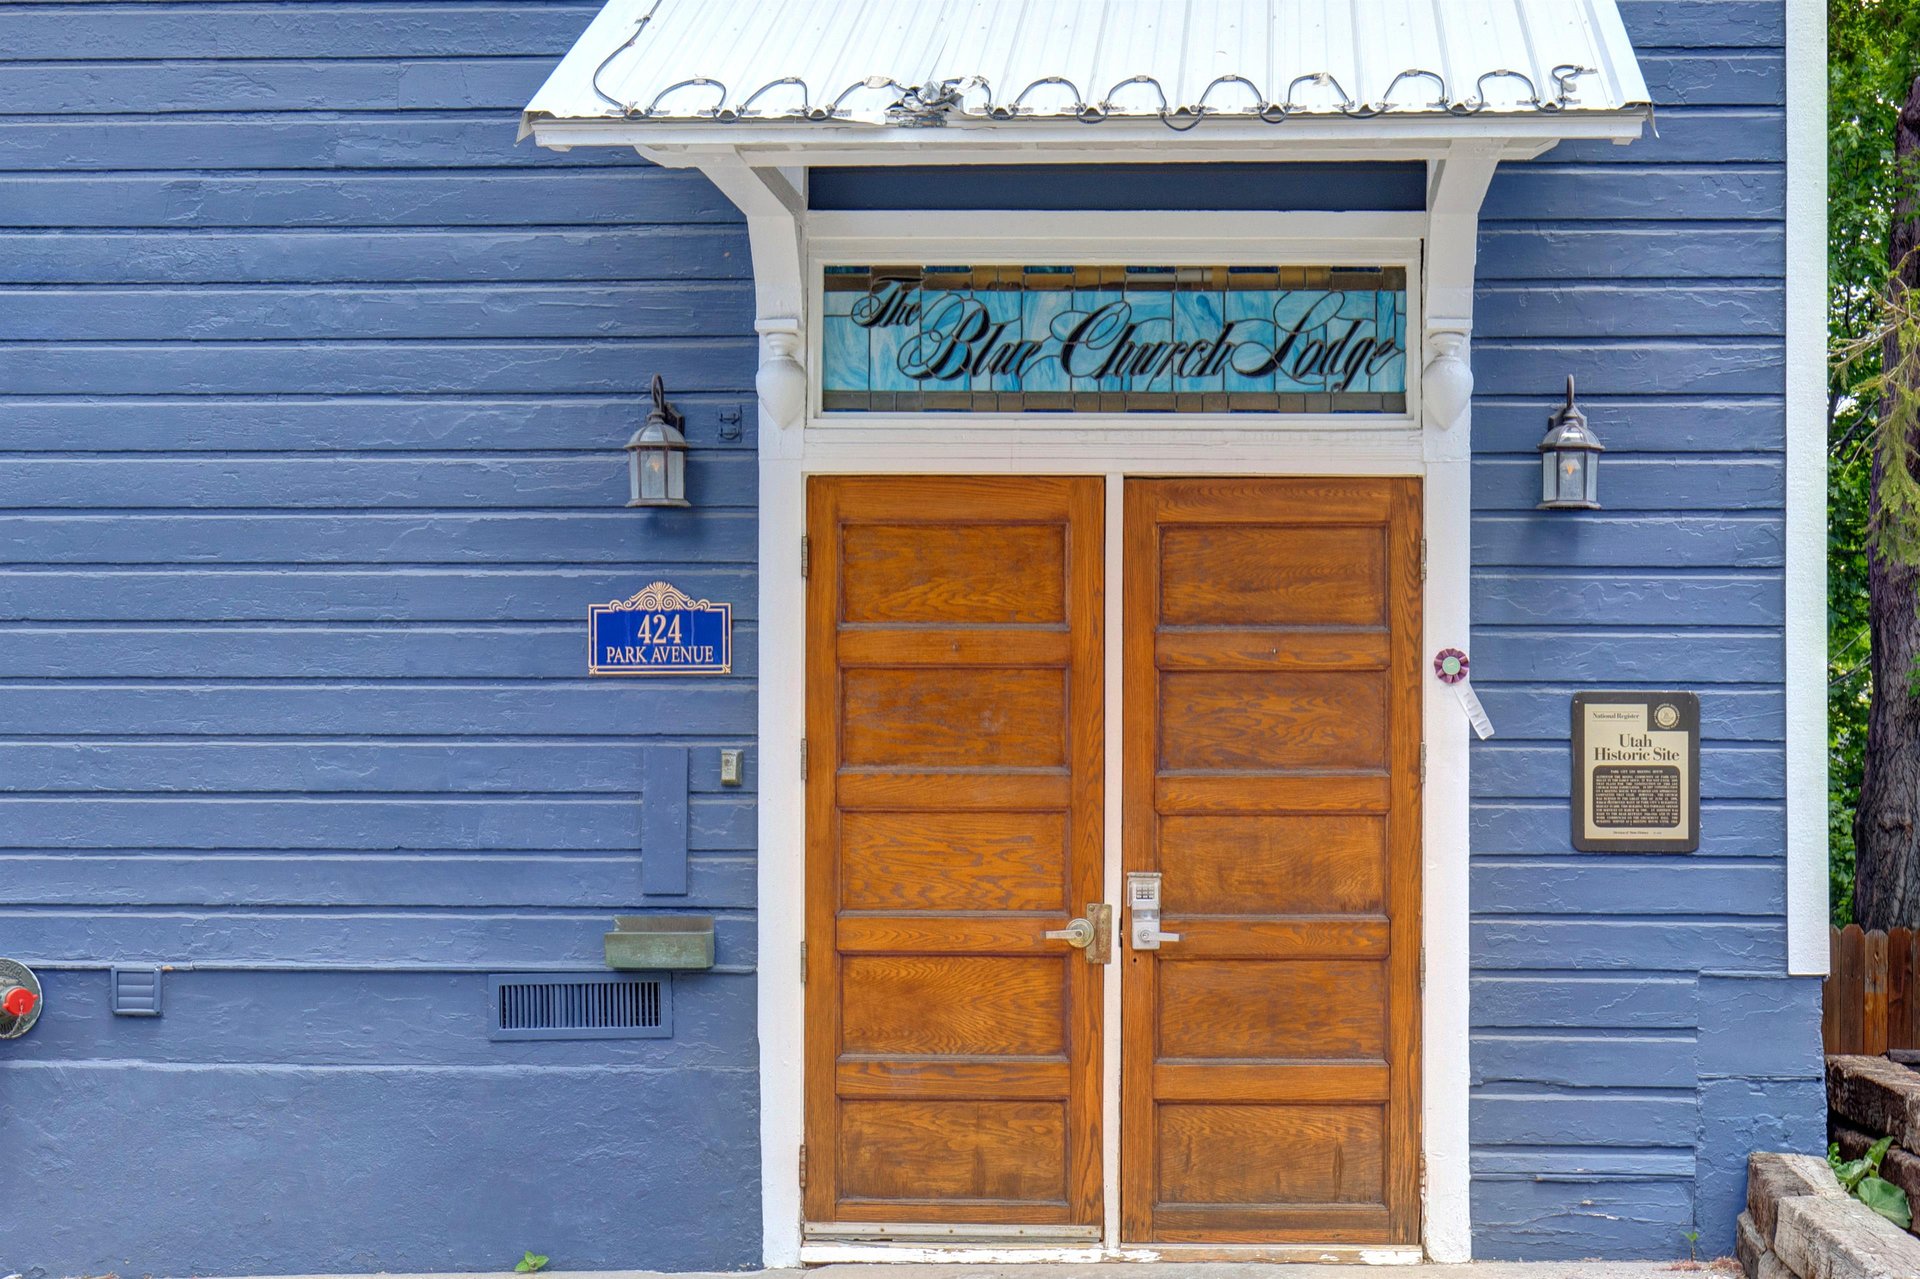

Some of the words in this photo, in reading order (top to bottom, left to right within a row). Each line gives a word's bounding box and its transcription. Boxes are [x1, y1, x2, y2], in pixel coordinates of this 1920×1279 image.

[851, 276, 924, 328] The
[897, 293, 1043, 381] Blue
[1050, 300, 1237, 380] Church
[1231, 291, 1397, 393] Lodge
[637, 613, 682, 645] 424
[606, 645, 648, 664] PARK
[651, 645, 714, 664] AVENUE
[1592, 711, 1616, 720] National
[1616, 711, 1640, 721] Register
[1619, 733, 1653, 748] Utah
[1593, 747, 1651, 761] Historic
[1653, 747, 1680, 761] Site
